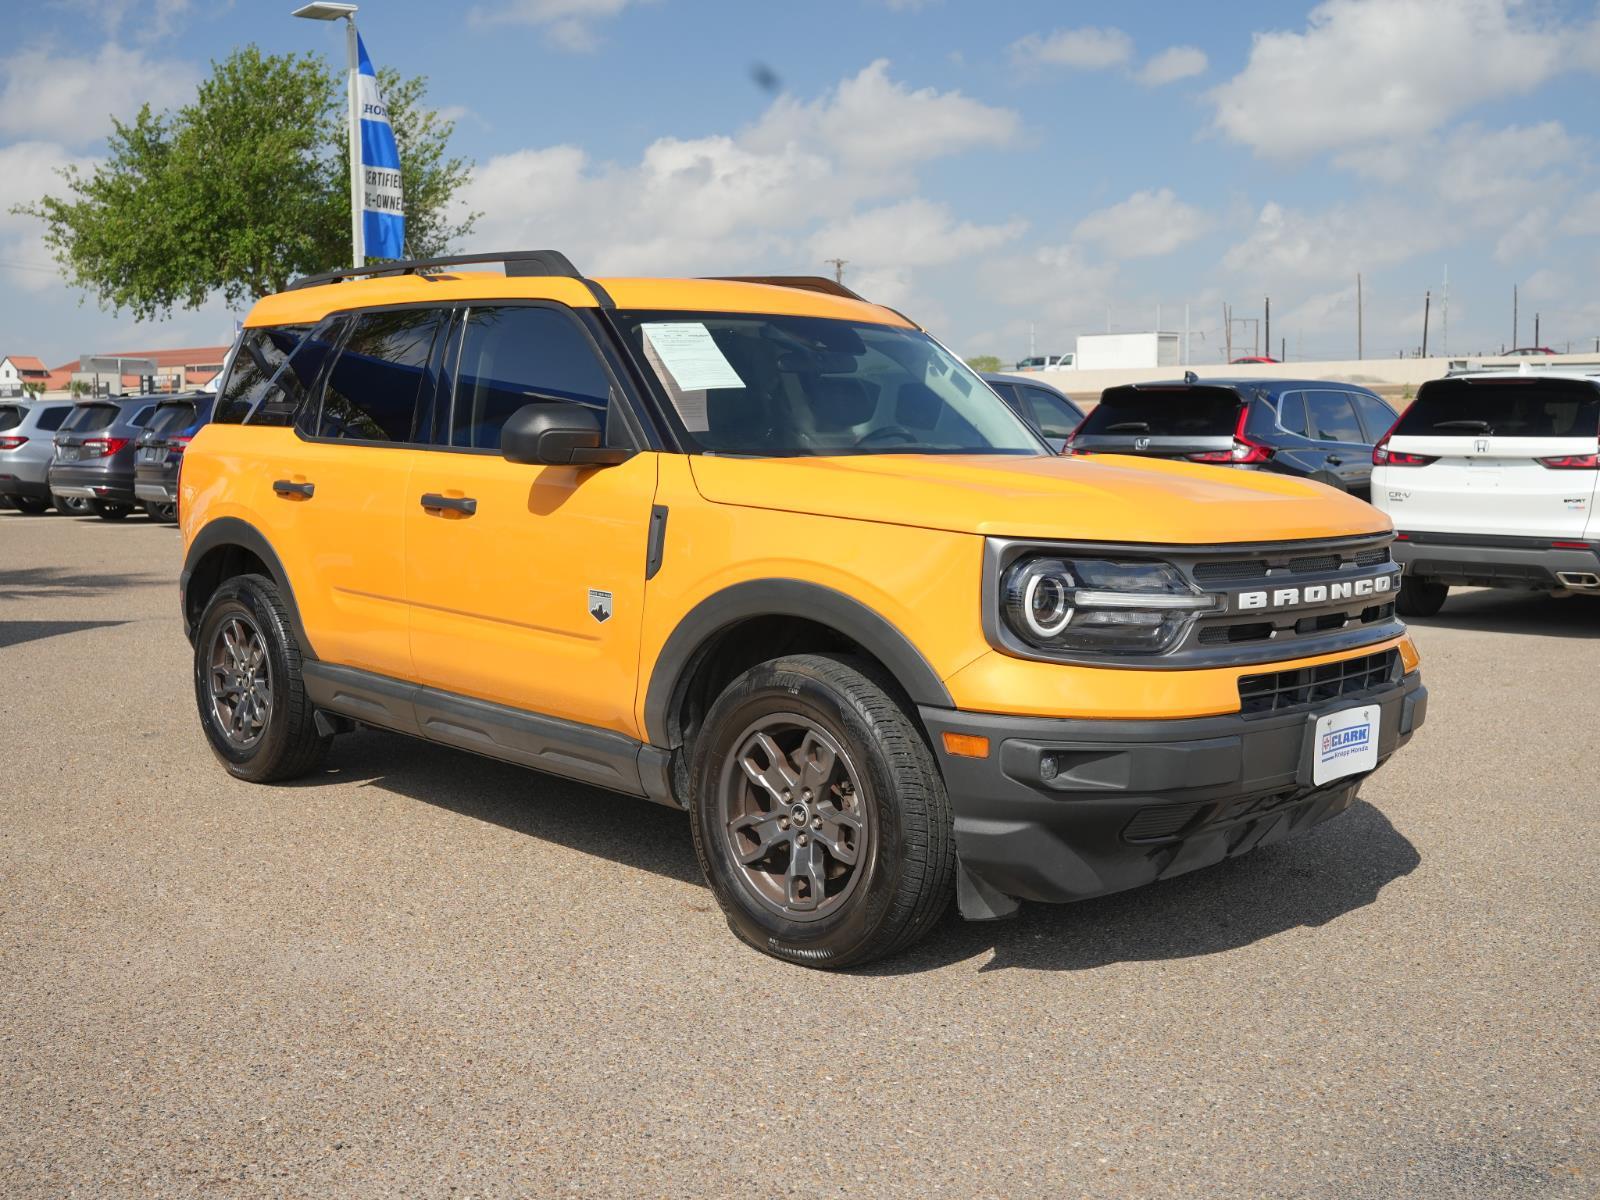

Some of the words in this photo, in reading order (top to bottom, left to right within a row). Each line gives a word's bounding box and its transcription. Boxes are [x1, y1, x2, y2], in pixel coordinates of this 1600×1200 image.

[1238, 575, 1391, 610] BRONCO
[1331, 728, 1367, 747] CLARK
[1350, 745, 1369, 754] Honda
